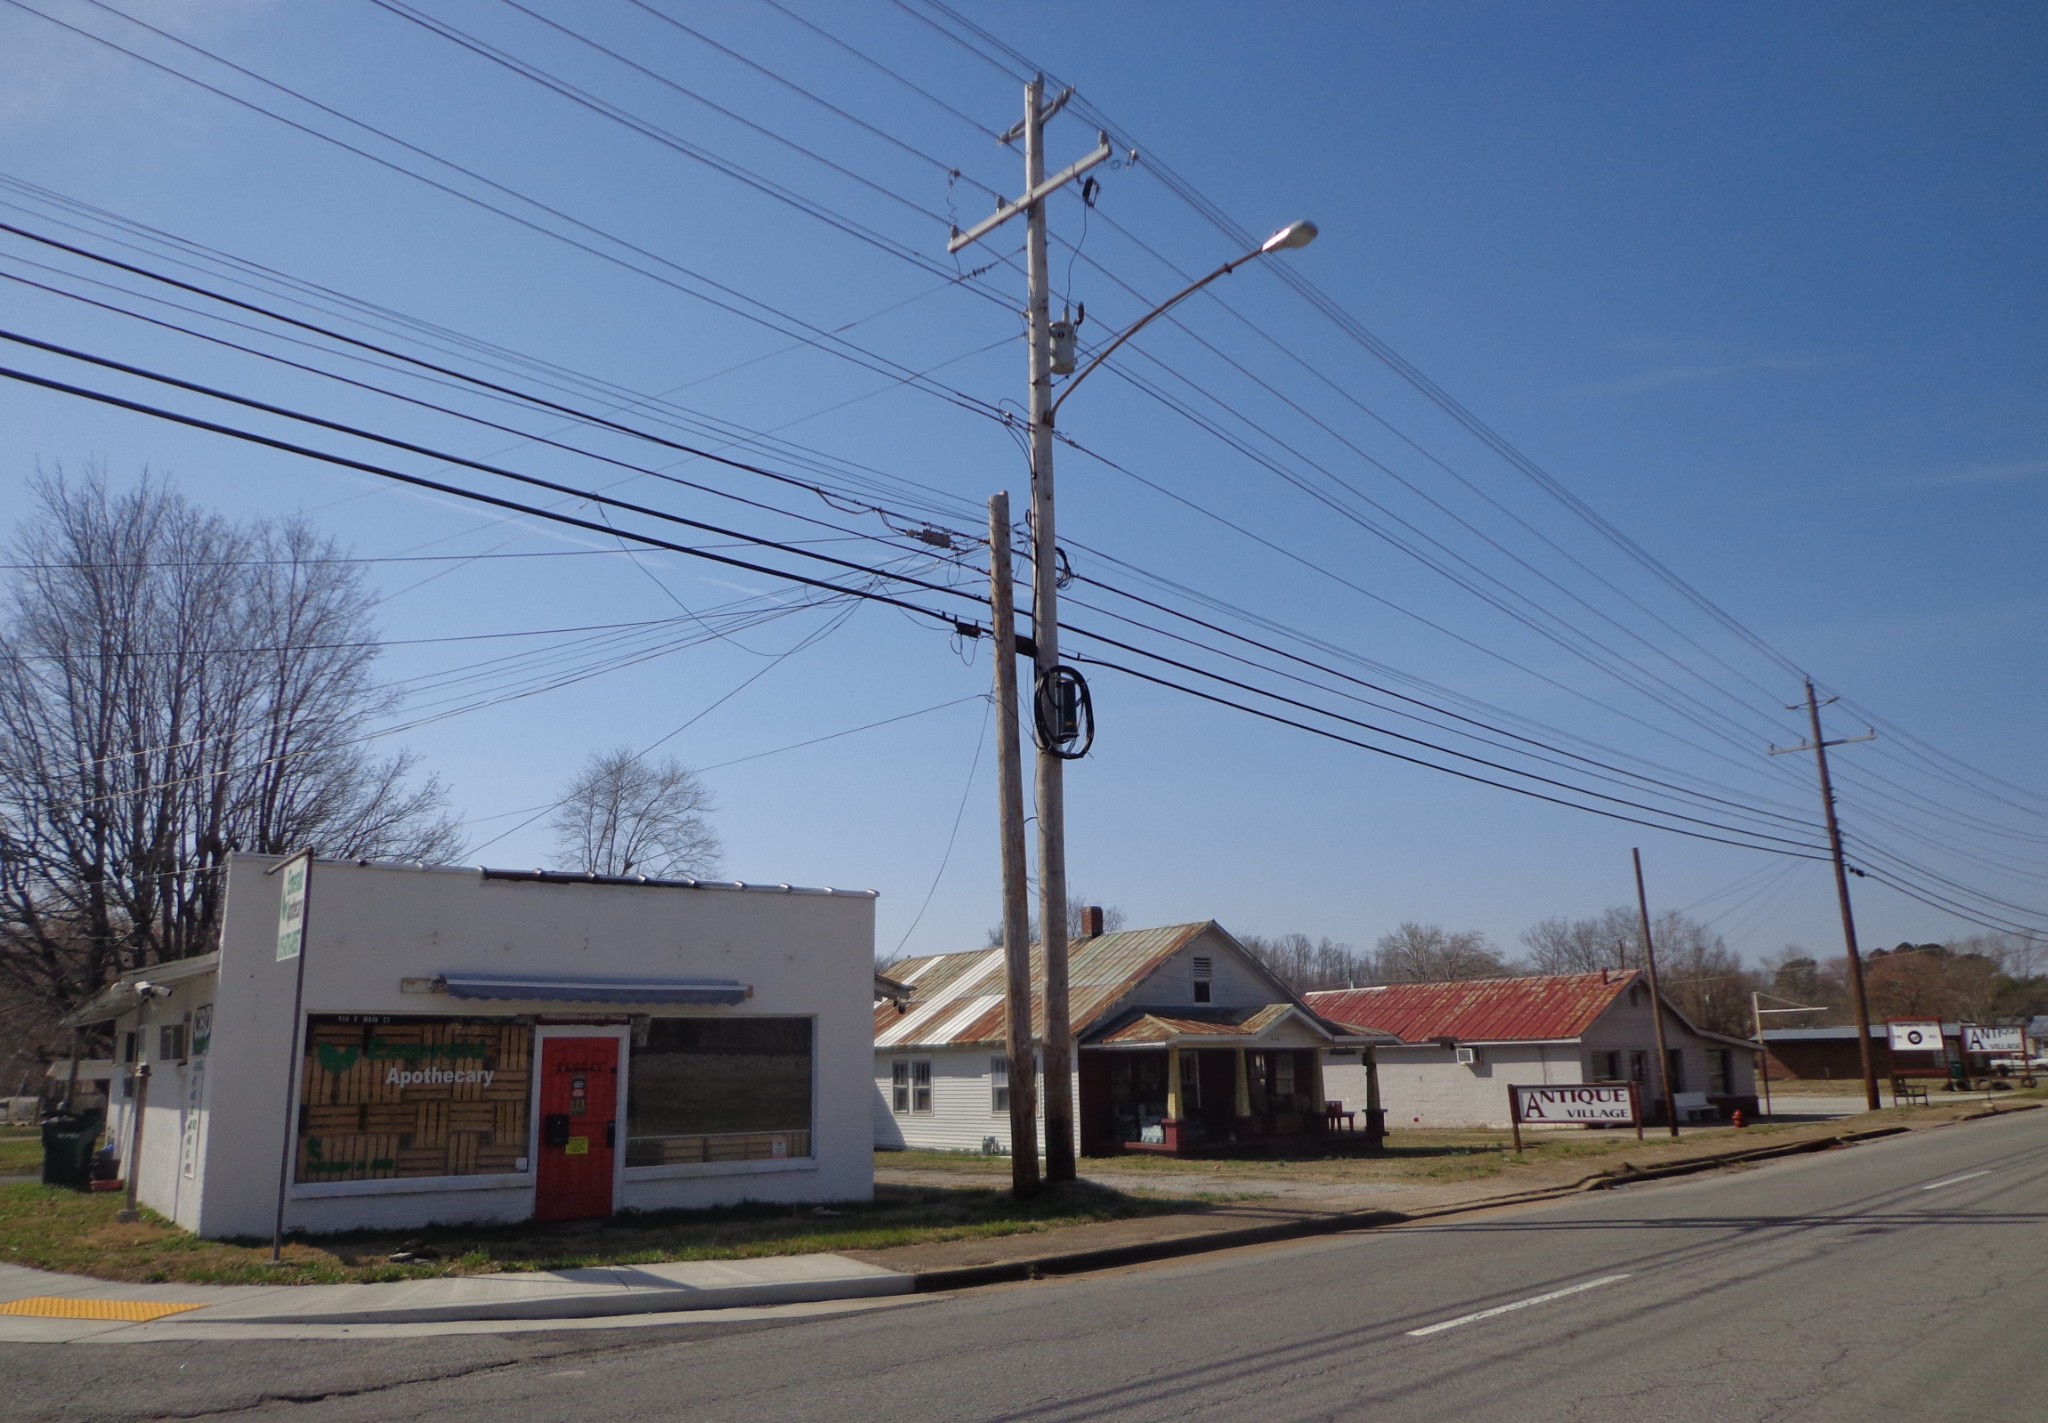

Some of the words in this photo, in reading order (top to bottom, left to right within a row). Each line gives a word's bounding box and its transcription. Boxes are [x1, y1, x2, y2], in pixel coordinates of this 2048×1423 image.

[1970, 1027, 2019, 1049] ANTIQUE
[385, 1066, 494, 1088] Apothecary
[1525, 1089, 1628, 1118] ANTIQUE
[1566, 1109, 1630, 1118] VILLAGE
